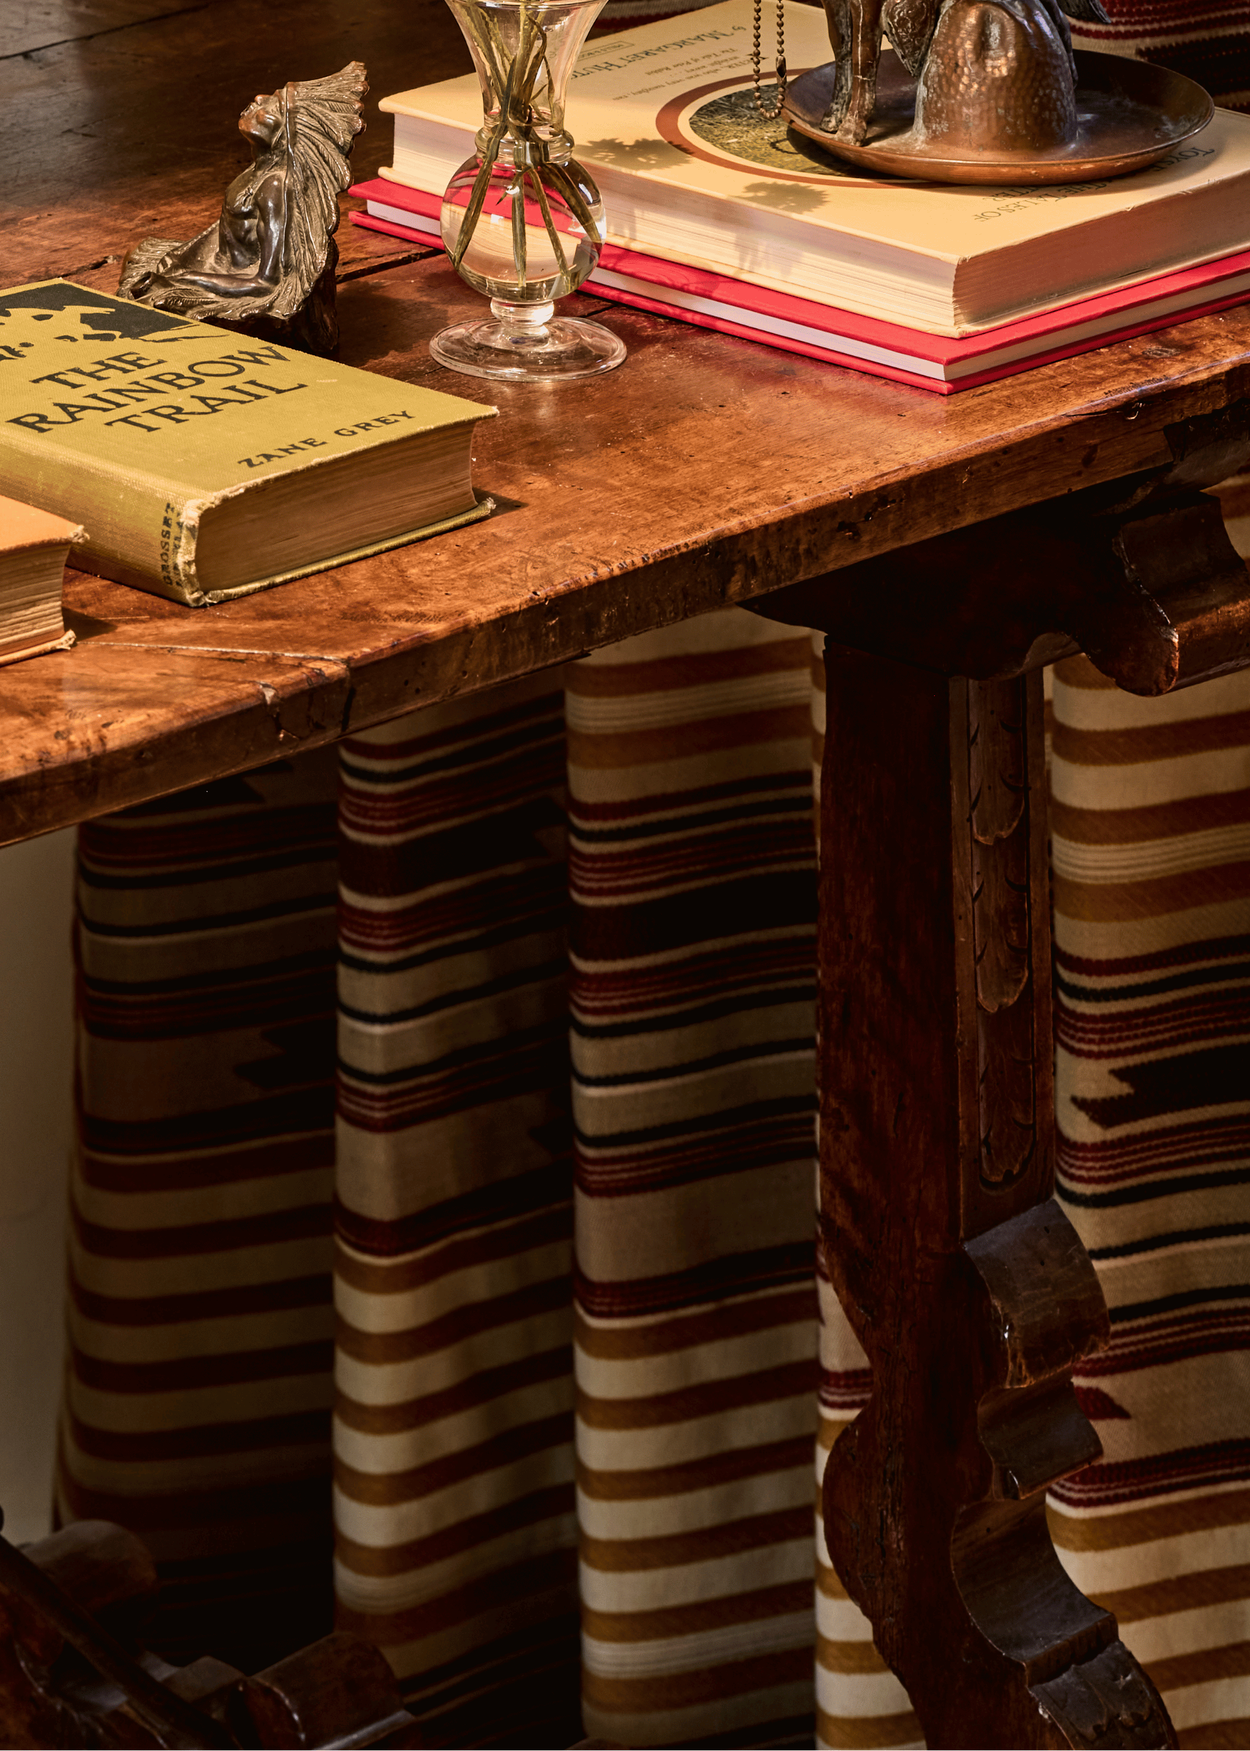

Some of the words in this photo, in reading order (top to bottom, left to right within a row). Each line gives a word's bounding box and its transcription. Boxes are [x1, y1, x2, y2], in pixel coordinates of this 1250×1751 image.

[619, 30, 734, 66] MARGARET
[5, 346, 291, 433] RAINBOW
[29, 351, 168, 390] THE
[104, 379, 308, 432] TRAIL
[237, 438, 328, 468] ZANE
[334, 410, 416, 437] GREY
